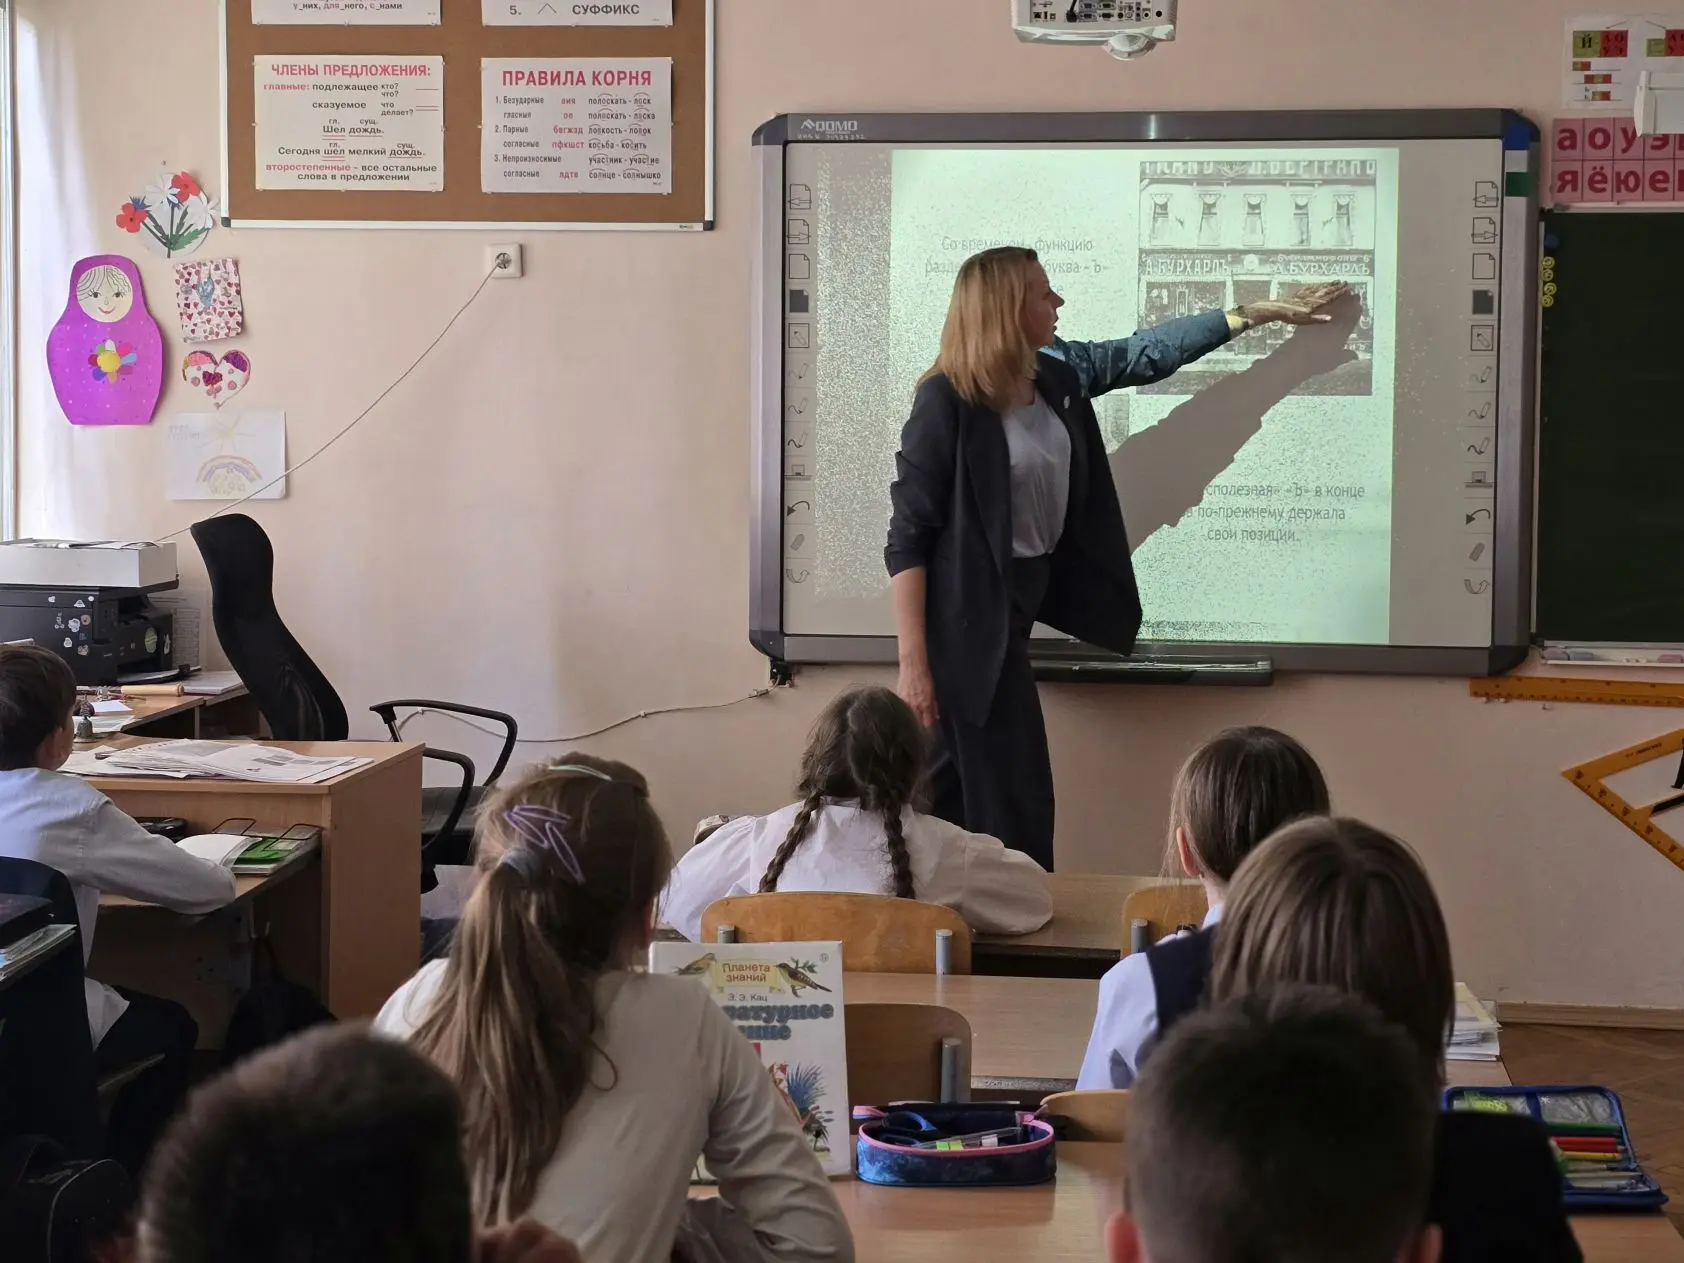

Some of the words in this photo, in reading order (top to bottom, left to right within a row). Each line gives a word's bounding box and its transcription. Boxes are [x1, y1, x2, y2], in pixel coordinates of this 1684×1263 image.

[510, 6, 522, 15] 5.
[572, 4, 640, 15] СУФФИКС
[272, 64, 319, 76] ЧЛЕНЫ
[324, 64, 430, 78] ПРЕДЛОЖЕНИЯ:
[502, 70, 586, 86] ПРАВИЛА
[592, 70, 652, 86] КОРНЯ
[264, 83, 310, 91] главные:
[312, 84, 378, 92] подлежащее
[504, 96, 544, 105] Безударные
[349, 126, 384, 134] дождь.
[1556, 128, 1578, 150] а
[1588, 128, 1611, 150] о
[1620, 126, 1638, 154] у
[552, 141, 584, 150] пфкшст
[278, 147, 320, 156] Сегодня
[503, 155, 561, 163] Непроизносимые
[589, 156, 622, 165] участник
[630, 156, 659, 165] участие
[1556, 170, 1578, 193] я
[1588, 166, 1608, 193] ё
[1615, 170, 1640, 193] ю
[1650, 170, 1670, 192] е
[1034, 237, 1093, 252] функцию
[1315, 487, 1322, 497] в
[1326, 487, 1365, 498] конце
[1198, 507, 1284, 522] по-прежнему
[1289, 508, 1345, 522] держала
[1207, 530, 1237, 541] свои
[722, 962, 771, 973] Планета
[726, 972, 767, 983] знаний
[728, 994, 737, 1002] Э.
[739, 994, 748, 1002] Э.
[750, 994, 768, 1003] Кац
